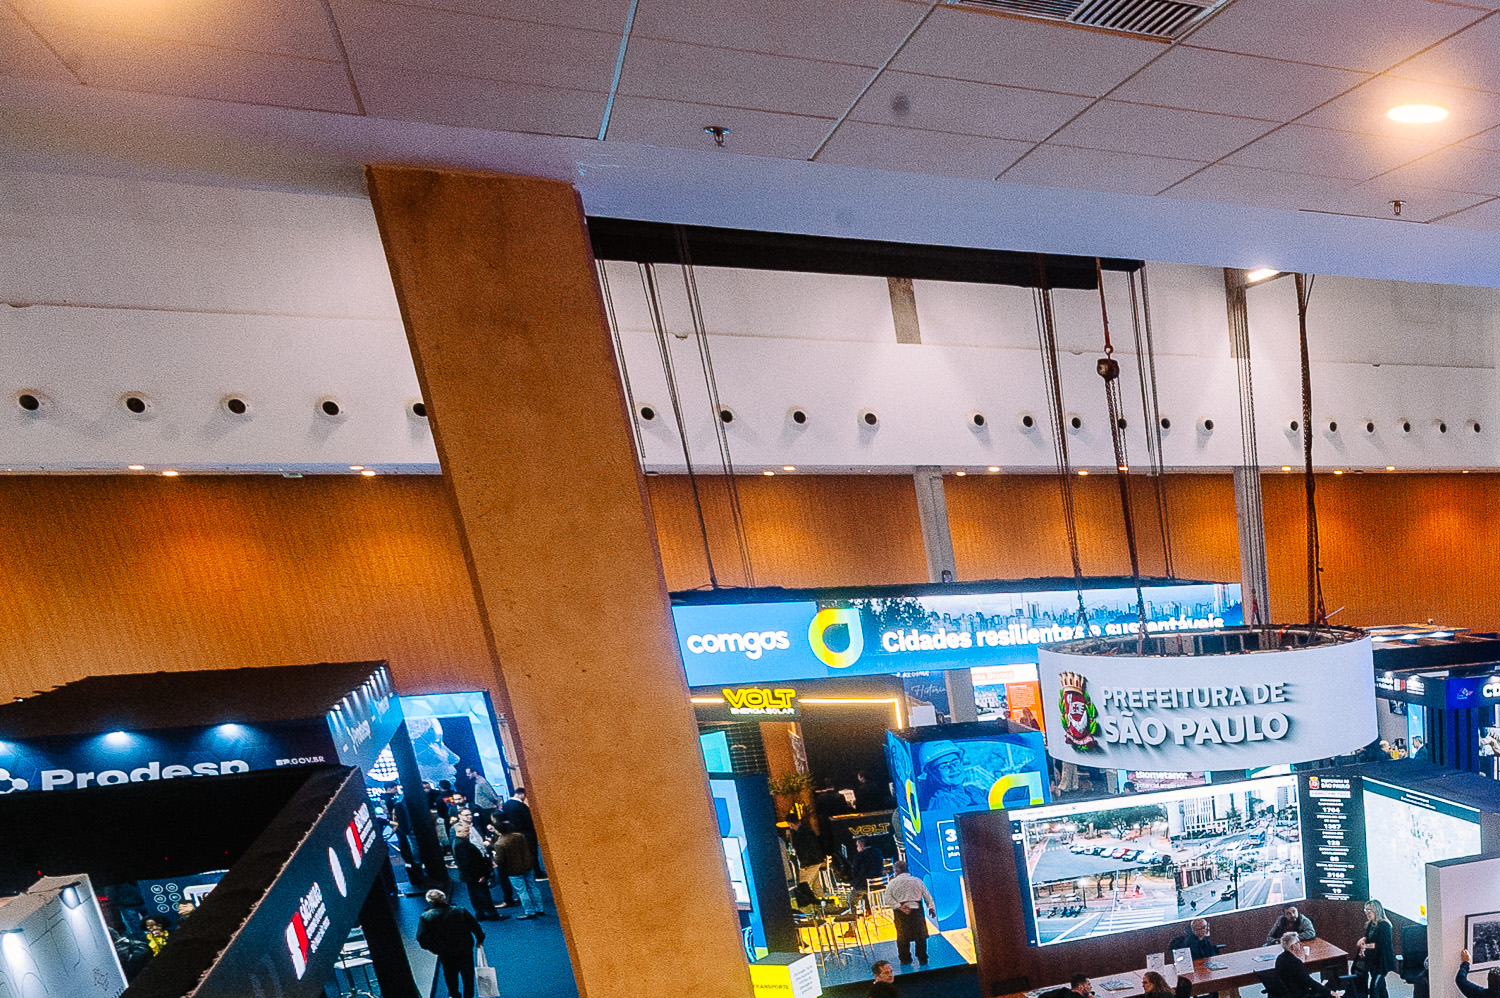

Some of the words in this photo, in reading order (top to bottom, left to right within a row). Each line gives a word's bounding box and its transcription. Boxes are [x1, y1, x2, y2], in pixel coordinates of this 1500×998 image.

[687, 631, 790, 660] comgas
[882, 628, 972, 652] Cidades
[976, 622, 1084, 647] resilientes
[1105, 613, 1225, 635] susentáveis
[722, 688, 797, 709] VOLT
[1102, 685, 1246, 709] PREFEITURA
[1253, 682, 1285, 704] DE
[1103, 711, 1167, 746] SÃO
[1173, 711, 1289, 746] PAULO
[41, 759, 250, 791] Prodesp
[848, 823, 890, 836] VOLT
